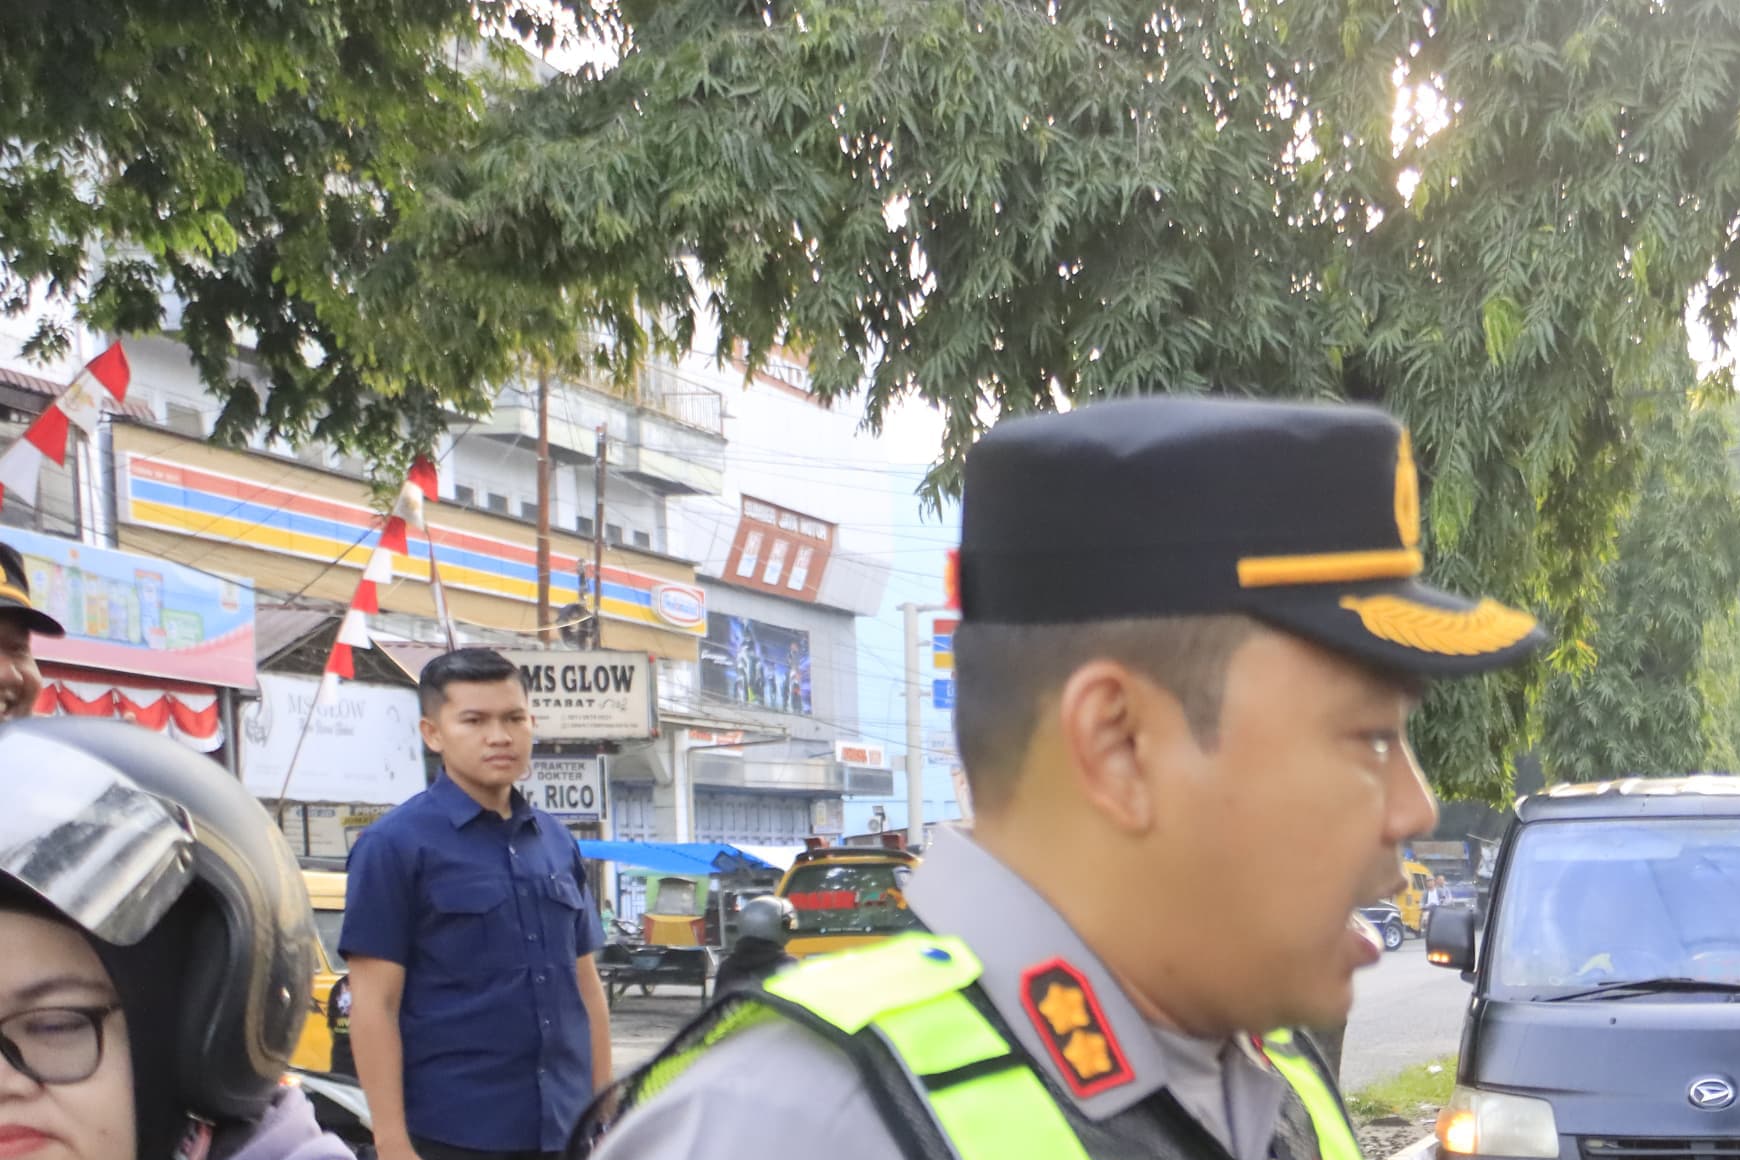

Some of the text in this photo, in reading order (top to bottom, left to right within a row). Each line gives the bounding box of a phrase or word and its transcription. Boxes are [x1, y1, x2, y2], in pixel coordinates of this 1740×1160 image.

[520, 665, 635, 694] MS GLOW
[532, 699, 595, 708] STABAT
[534, 761, 586, 771] PRAKTEK
[537, 771, 582, 780] DOKTER
[545, 784, 594, 809] RICO
